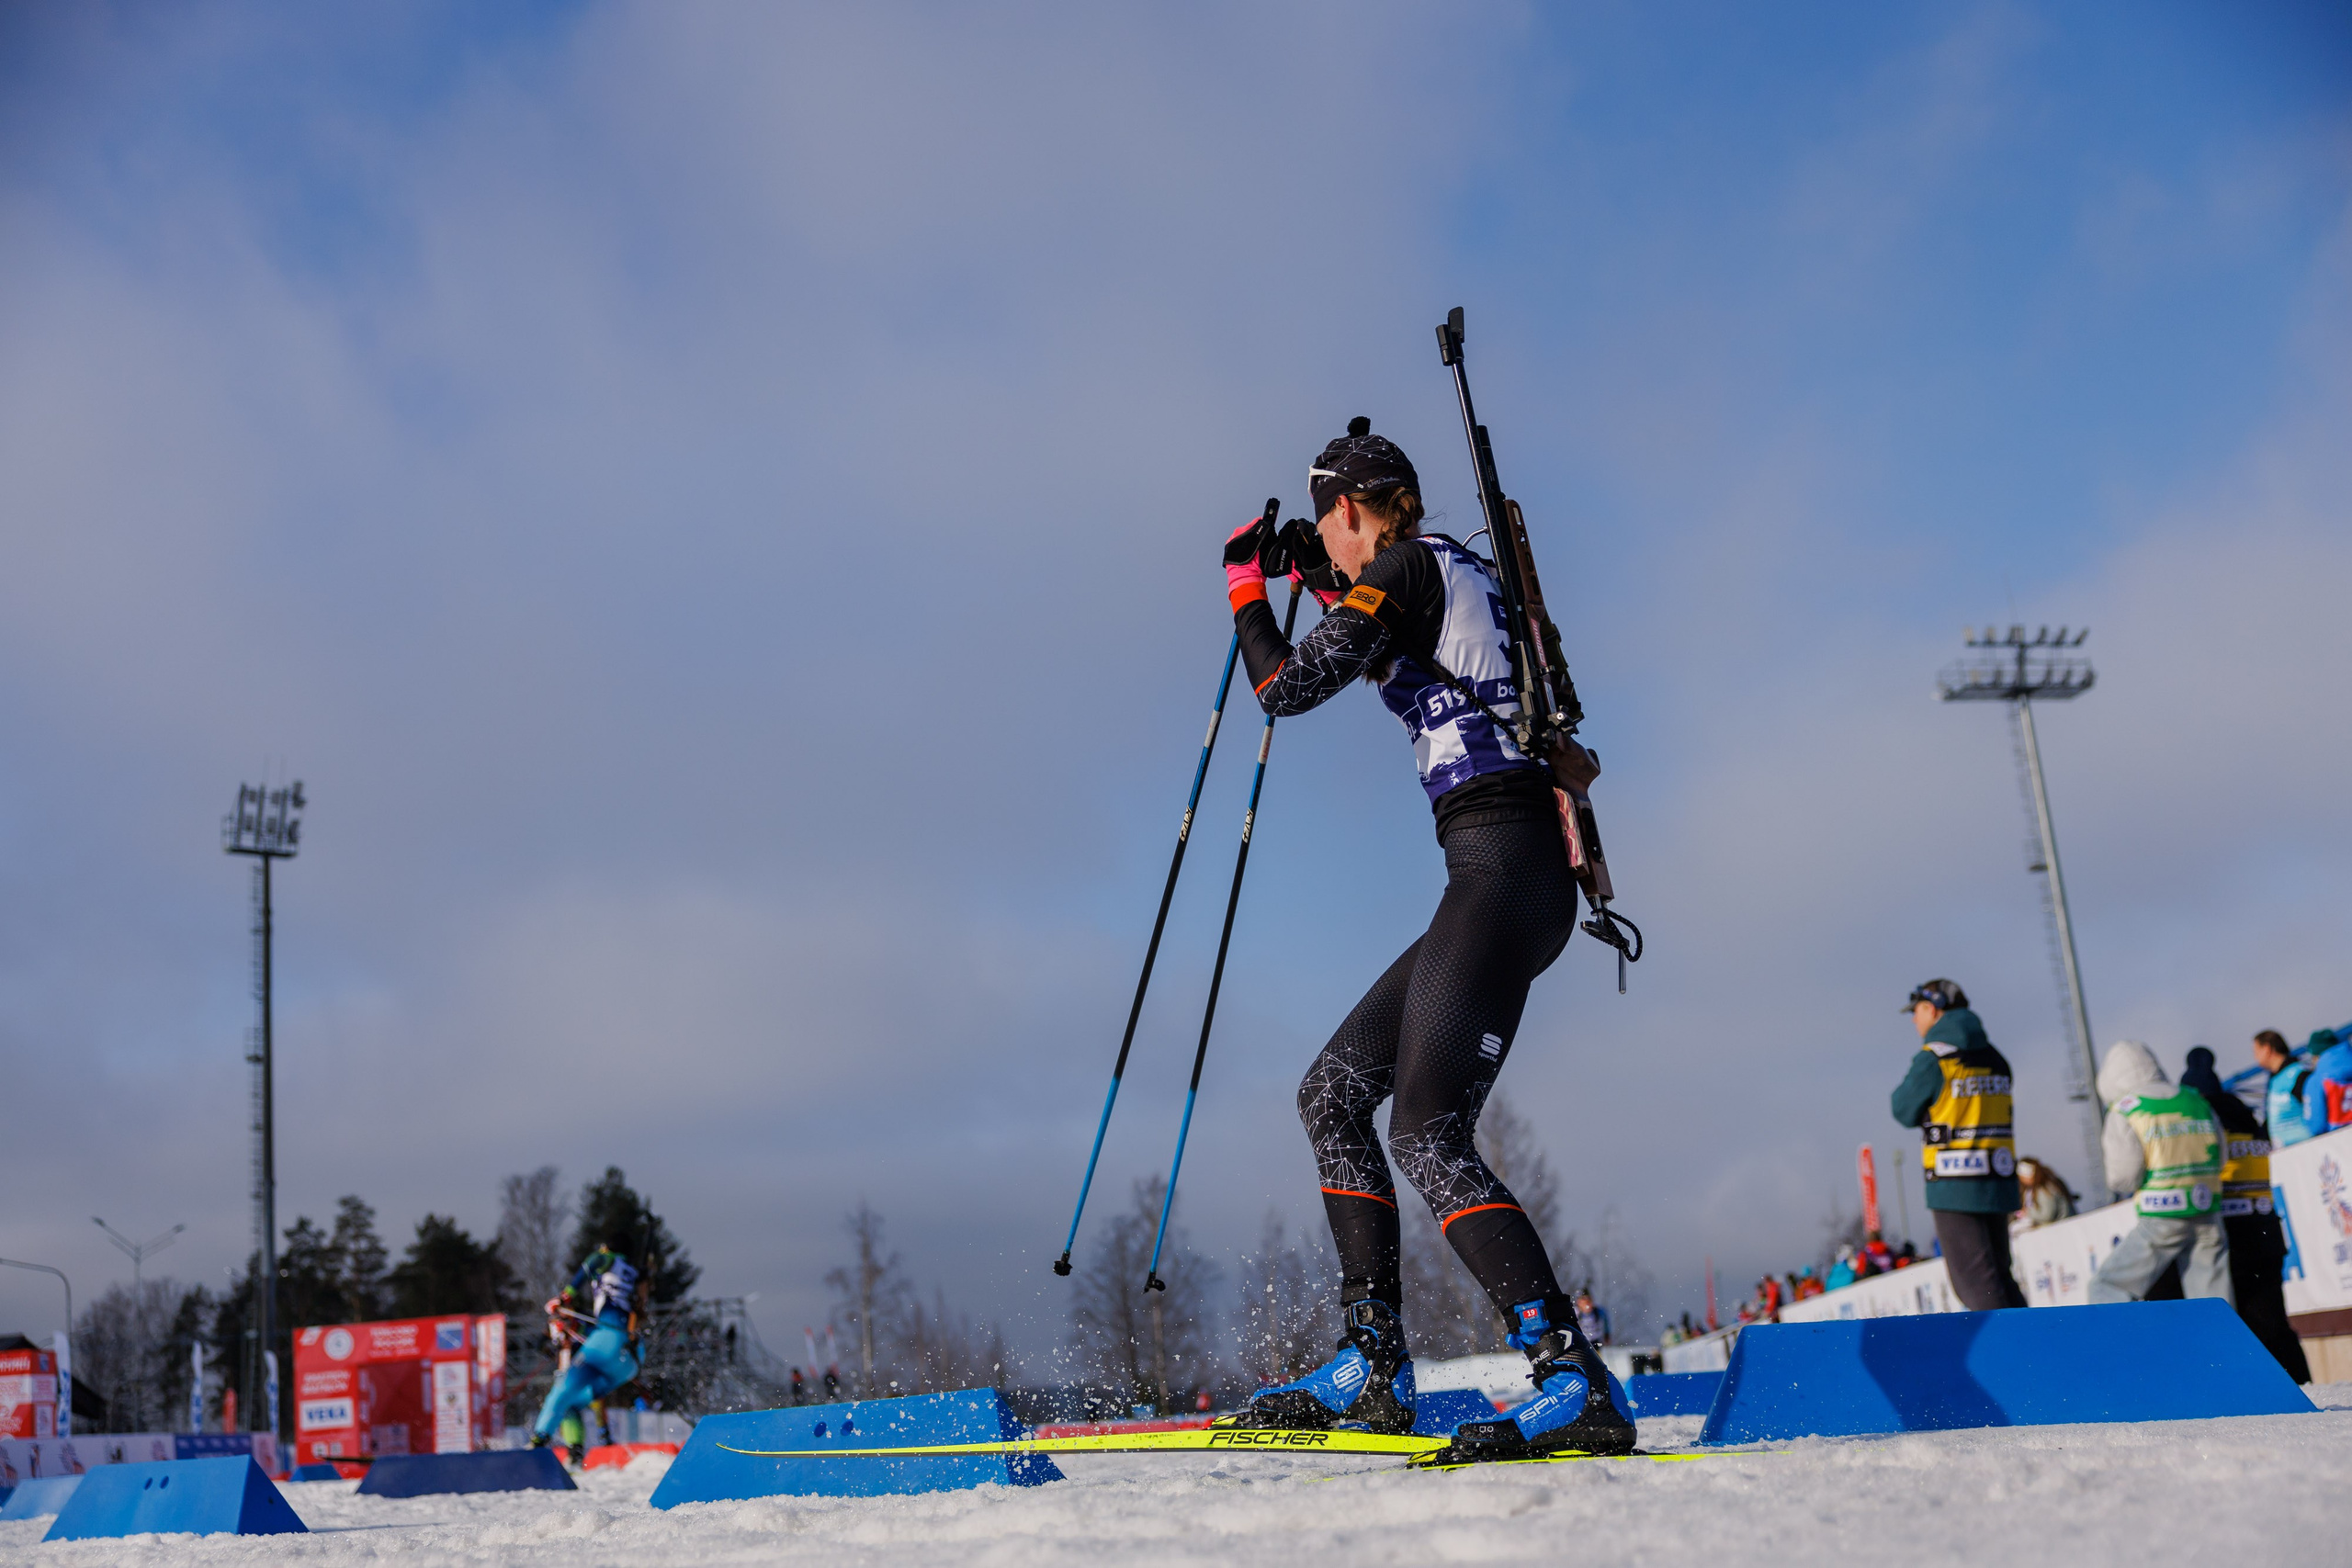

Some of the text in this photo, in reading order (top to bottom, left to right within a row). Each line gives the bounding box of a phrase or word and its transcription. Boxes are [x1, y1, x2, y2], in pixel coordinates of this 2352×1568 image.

[1350, 590, 1376, 604] ZERO
[1427, 689, 1467, 716] 519
[1930, 1127, 1940, 1142] 3
[1526, 1309, 1535, 1317] 19
[1519, 1379, 1583, 1423] SPINE
[306, 1405, 347, 1421] VEKA
[1209, 1432, 1329, 1447] FISCHER
